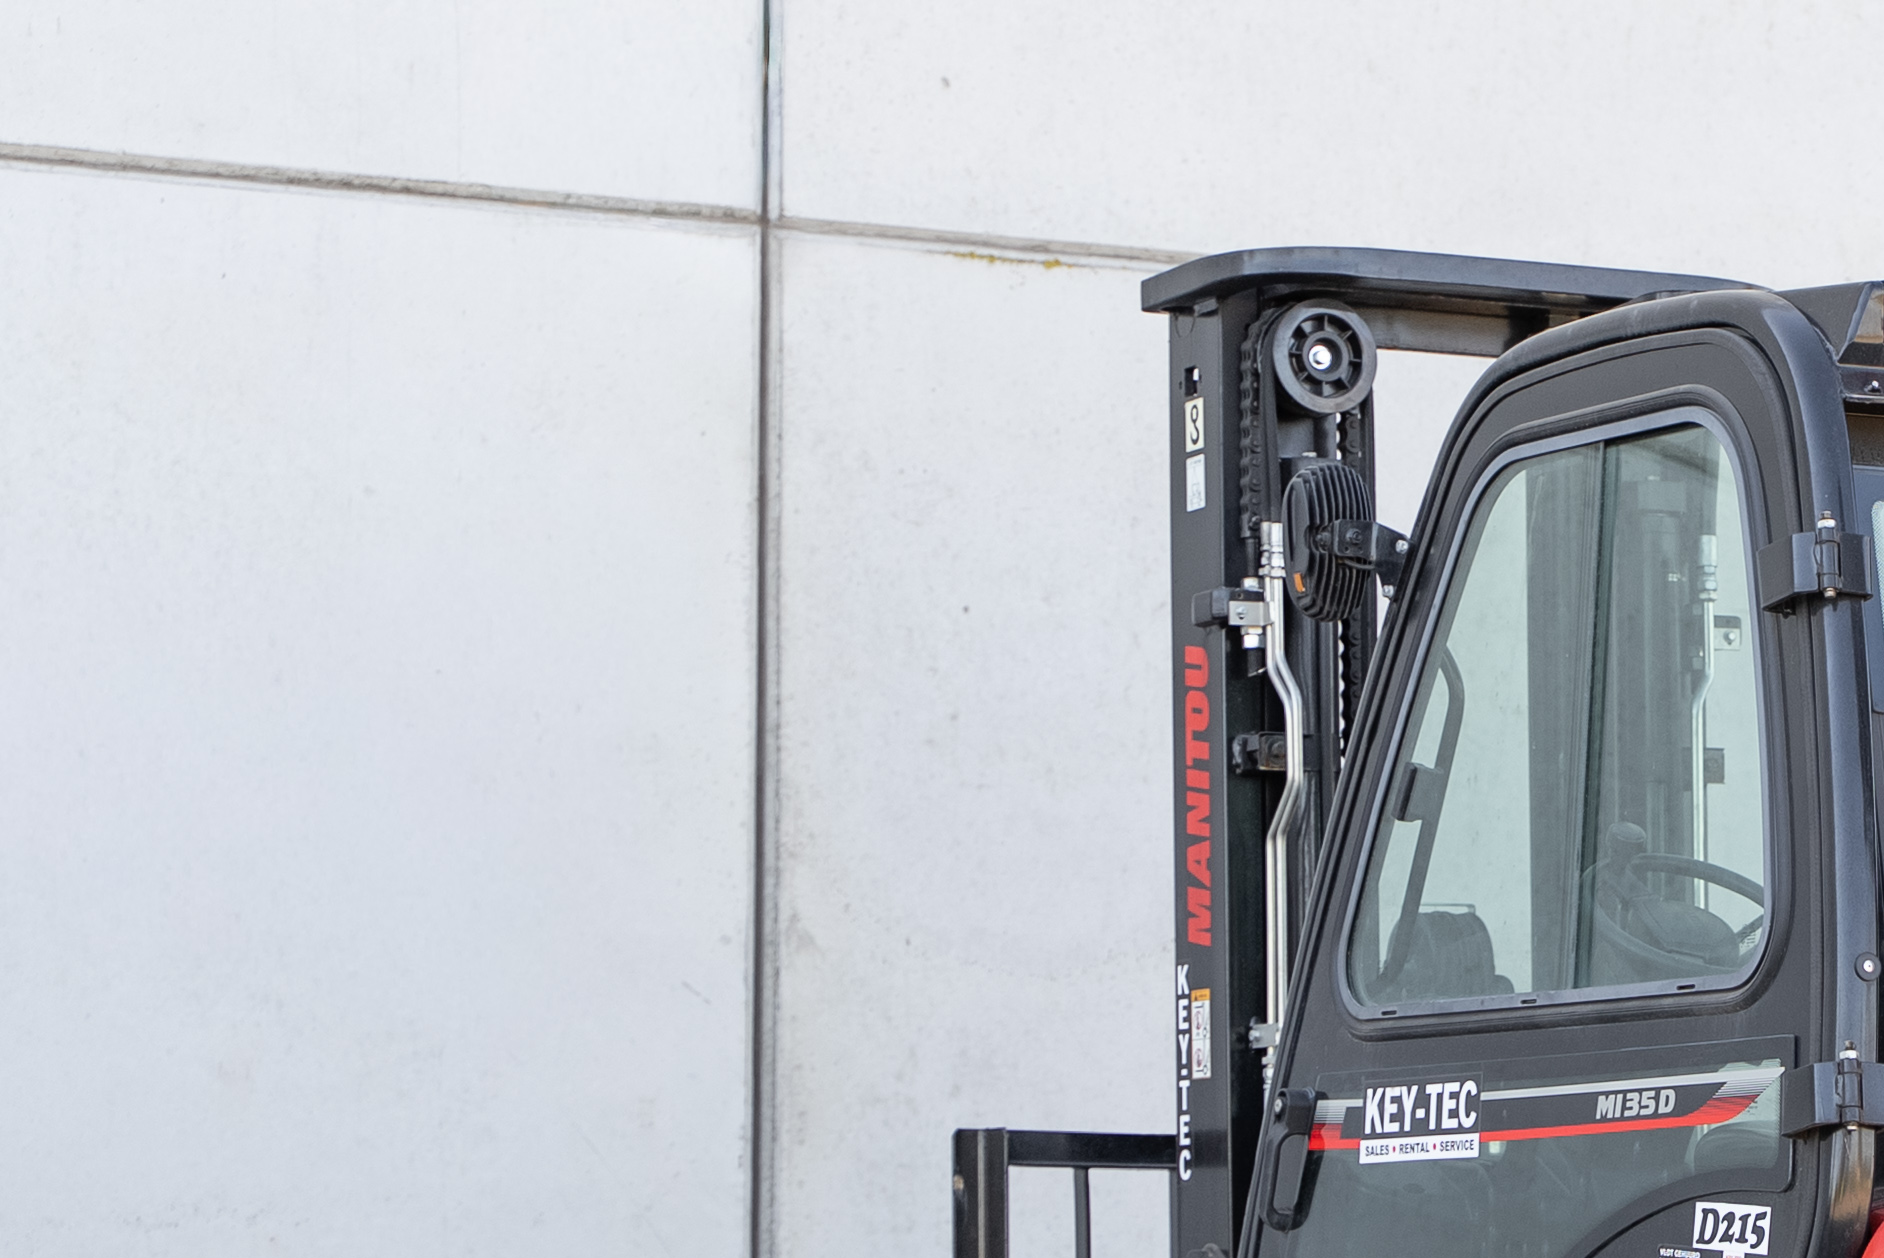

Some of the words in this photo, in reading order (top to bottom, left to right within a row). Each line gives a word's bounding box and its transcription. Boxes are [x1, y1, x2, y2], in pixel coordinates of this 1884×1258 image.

[1184, 645, 1212, 947] MANITOU
[1177, 964, 1192, 1181] KEY-TEC
[1364, 1080, 1478, 1135] KEY-TEC
[1365, 1144, 1390, 1157] SALES
[1399, 1142, 1430, 1154] RENTAL
[1439, 1139, 1475, 1152] SERVICE
[1695, 1207, 1767, 1249] D215
